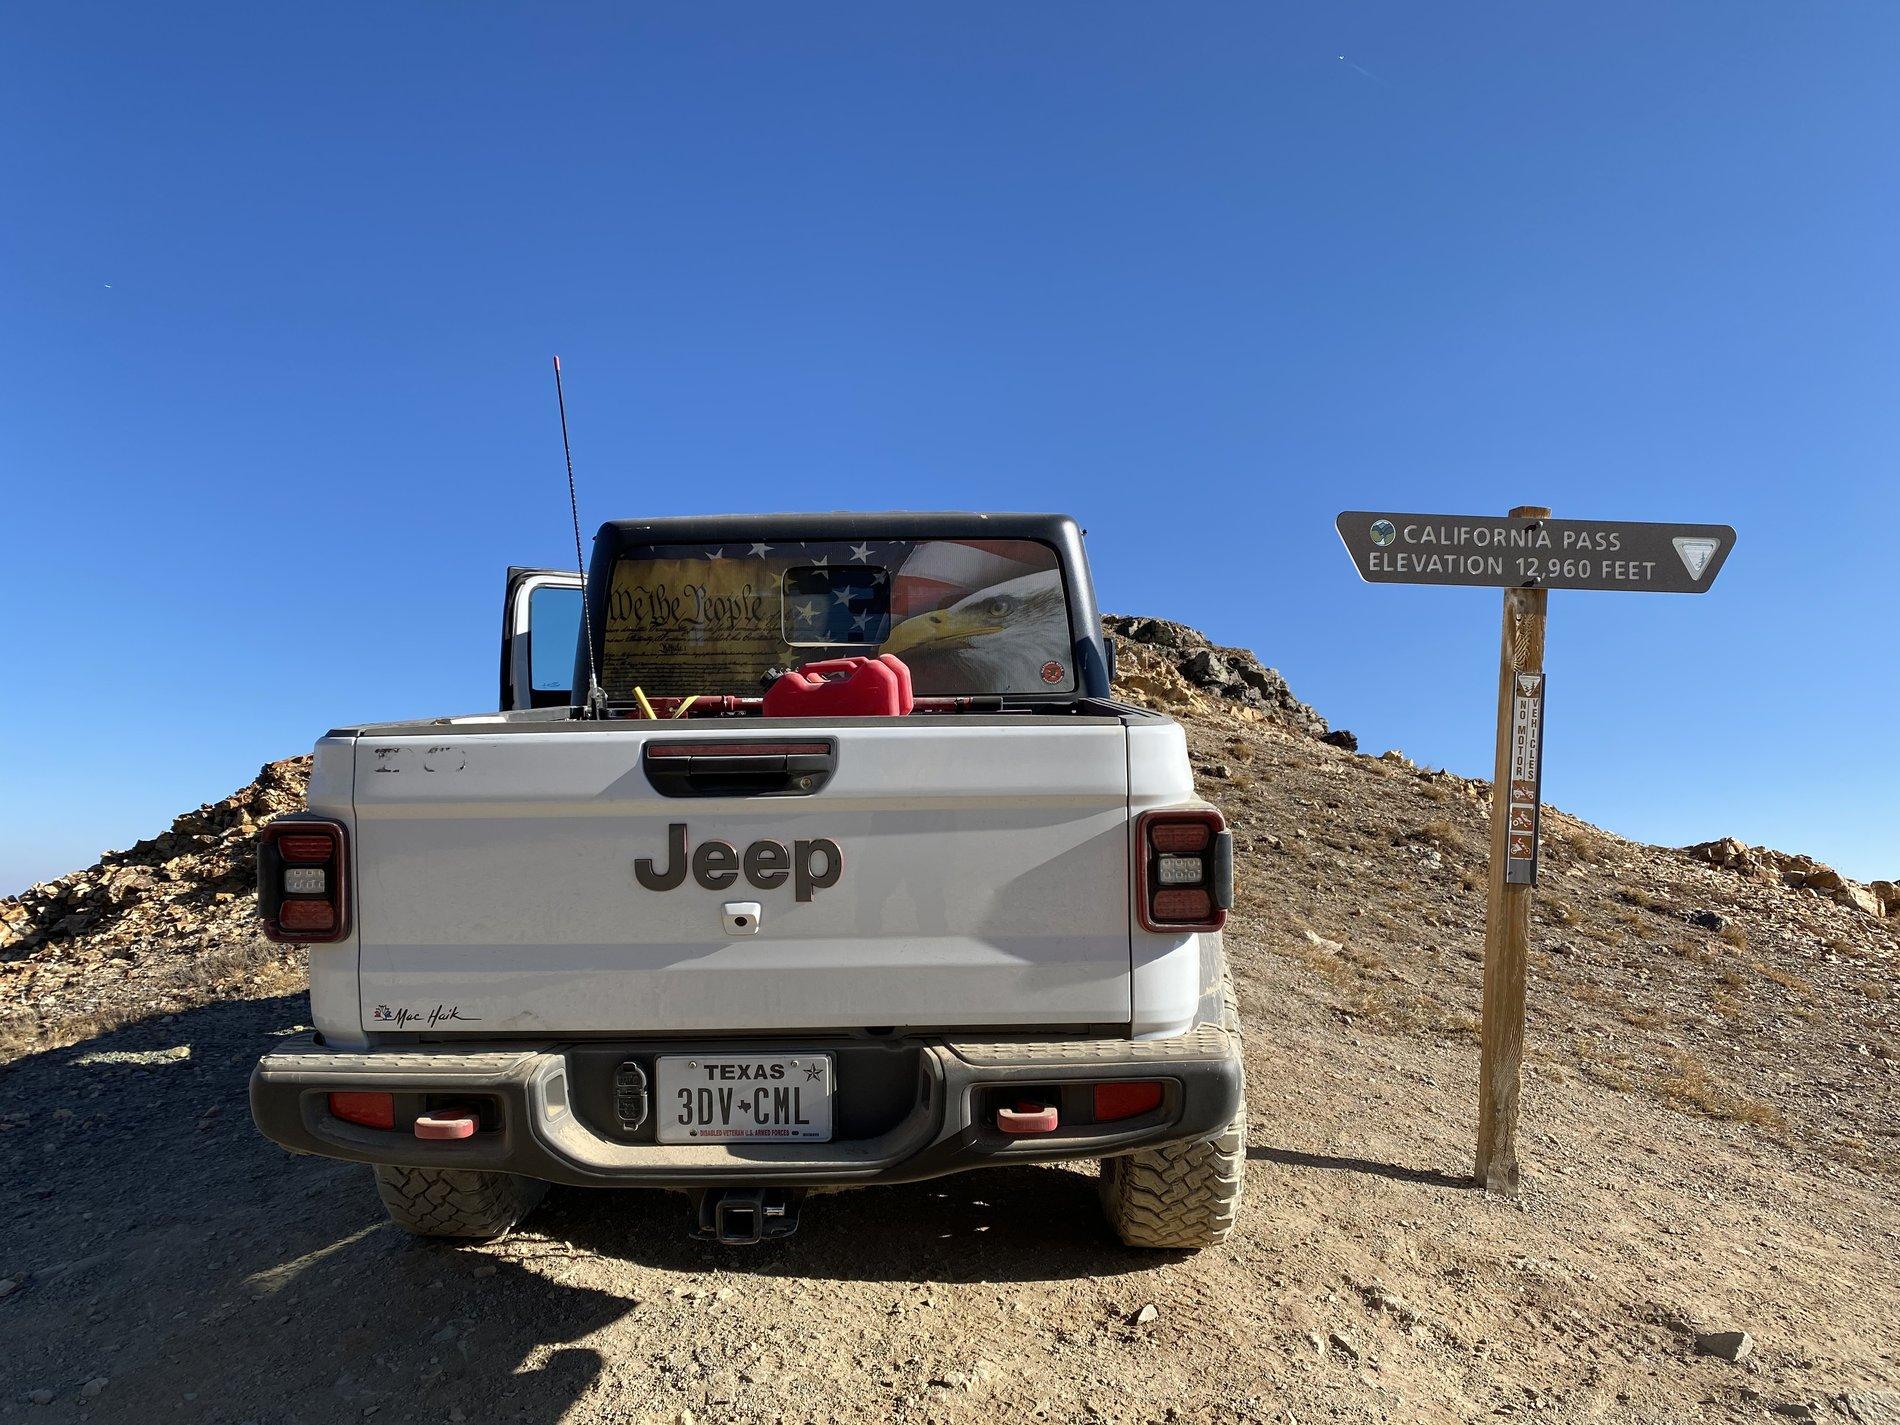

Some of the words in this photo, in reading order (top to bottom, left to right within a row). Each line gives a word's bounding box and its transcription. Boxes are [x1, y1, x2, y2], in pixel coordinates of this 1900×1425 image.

[1403, 524, 1552, 549] CALIFORNIA
[1563, 530, 1621, 552] PASS
[1369, 552, 1503, 576] ELEVATION
[1515, 556, 1591, 580] 12,960
[1601, 560, 1657, 581] FEET
[610, 582, 649, 627] We
[649, 583, 686, 626] the
[678, 582, 763, 629] People
[1519, 700, 1526, 720] NO
[1516, 725, 1526, 776] MOTOR
[1527, 699, 1539, 780] VEHICLES
[634, 823, 844, 902] Jeep
[394, 1008, 424, 1029] Mac
[427, 1004, 481, 1028] Haik
[704, 1064, 785, 1081] TEXAS
[677, 1087, 733, 1126] 3DV
[753, 1086, 810, 1125] CML
[699, 1129, 722, 1137] DISABLED
[723, 1129, 744, 1137] VETERAN
[754, 1129, 771, 1137] ARMED
[771, 1129, 790, 1137] FORCES
